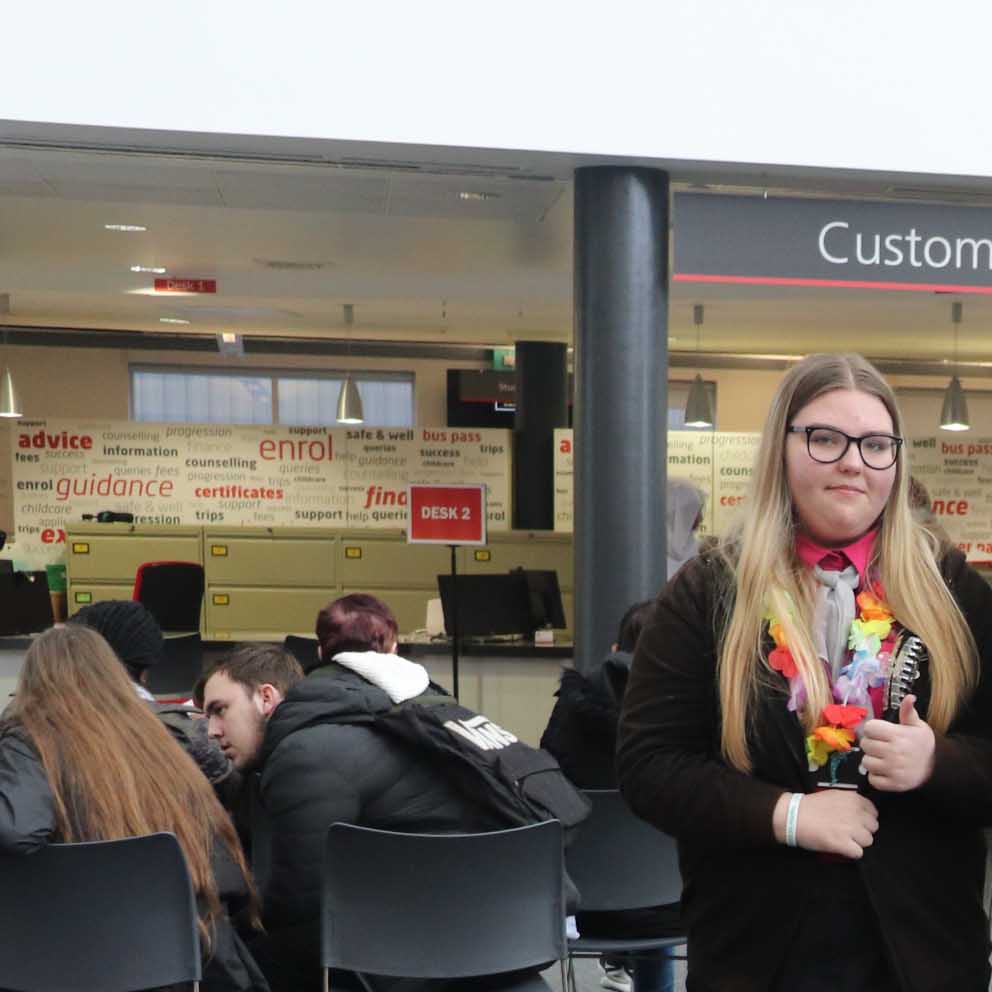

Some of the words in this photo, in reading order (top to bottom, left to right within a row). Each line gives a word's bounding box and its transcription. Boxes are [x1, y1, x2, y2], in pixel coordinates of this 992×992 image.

[166, 426, 233, 438] progression
[288, 427, 327, 436] support
[346, 429, 372, 440] safe
[376, 430, 385, 440] &
[388, 429, 414, 440] well
[422, 429, 447, 441] bus
[451, 431, 481, 443] pass
[18, 431, 93, 449] advice
[912, 438, 936, 449] well
[103, 445, 178, 457] information
[259, 435, 333, 461] enrol
[420, 448, 461, 457] success
[480, 444, 504, 456] trips
[941, 442, 964, 455] bus
[15, 452, 40, 463] fees
[668, 453, 711, 465] mation
[185, 457, 257, 471] counselling
[17, 479, 53, 490] enrol
[56, 473, 174, 500] guidance
[194, 485, 284, 499] certificates
[195, 511, 225, 522] trips
[295, 510, 343, 522] support
[372, 511, 408, 522] queri
[421, 506, 457, 520] DESK
[461, 507, 471, 520] 2
[487, 510, 505, 521] rol
[134, 514, 181, 525] ression
